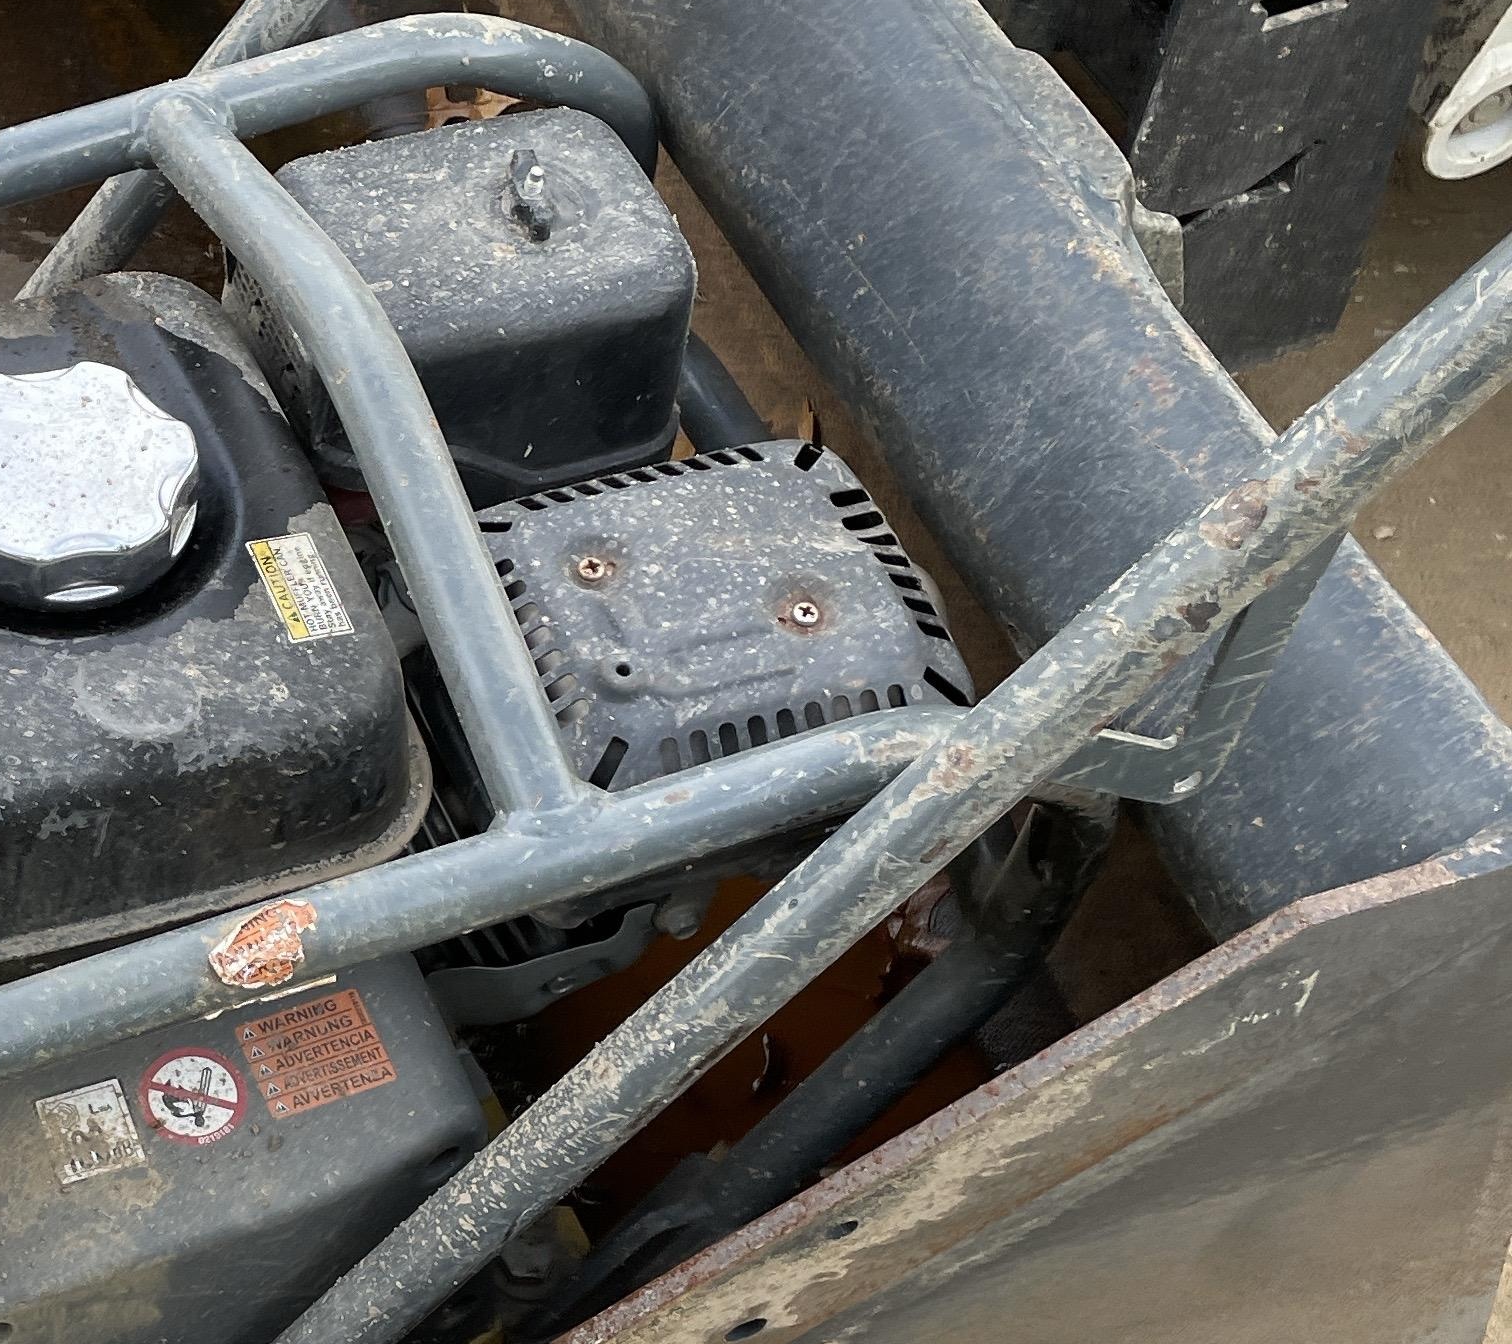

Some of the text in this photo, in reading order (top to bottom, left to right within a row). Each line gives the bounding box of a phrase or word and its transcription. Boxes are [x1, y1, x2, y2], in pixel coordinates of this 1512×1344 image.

[260, 556, 294, 610] CAUTION
[258, 999, 337, 1034] WARNING
[276, 1028, 376, 1072] ADVERTENCIA
